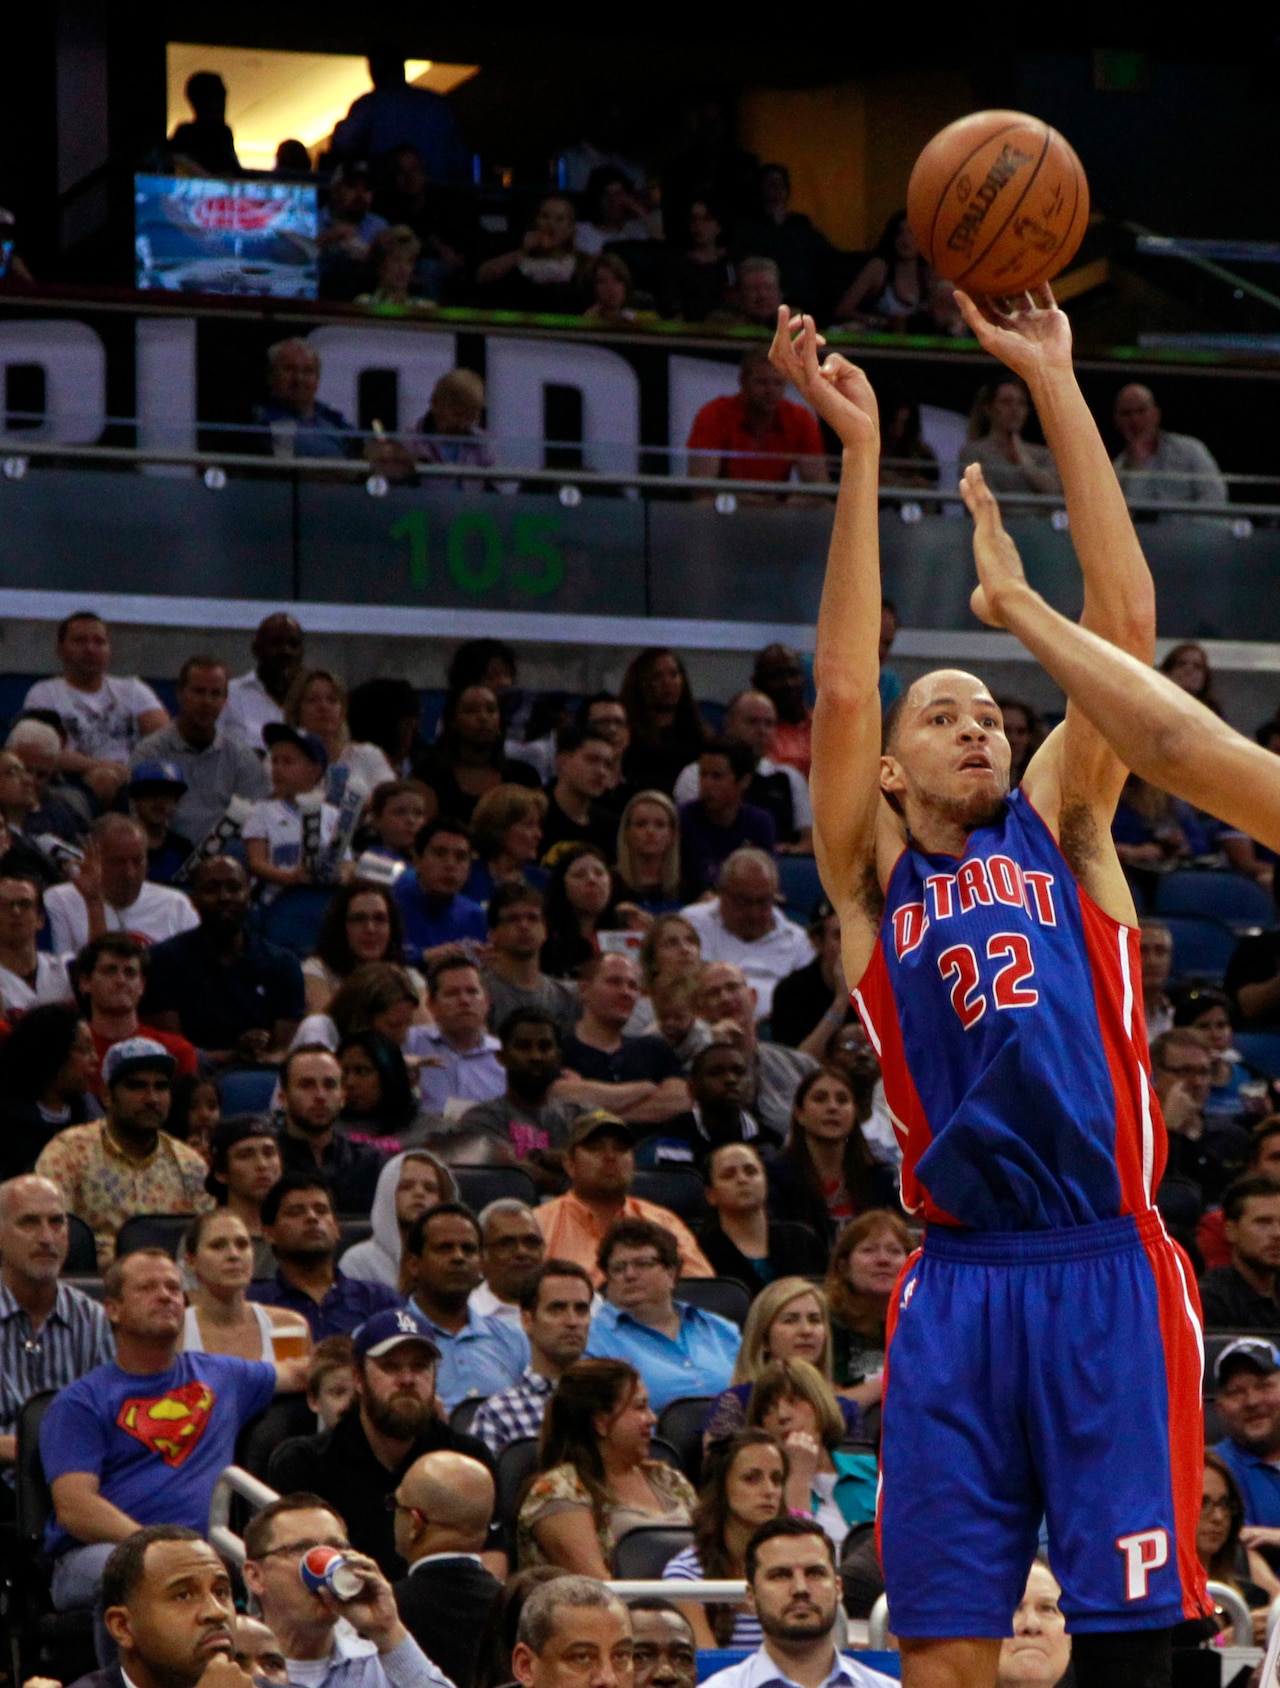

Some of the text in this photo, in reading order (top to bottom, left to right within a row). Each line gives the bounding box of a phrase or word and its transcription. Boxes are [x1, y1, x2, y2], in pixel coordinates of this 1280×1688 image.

[390, 510, 567, 596] 105
[892, 854, 1056, 964] DTROT
[937, 932, 1039, 1031] 22
[1115, 1526, 1170, 1601] P
